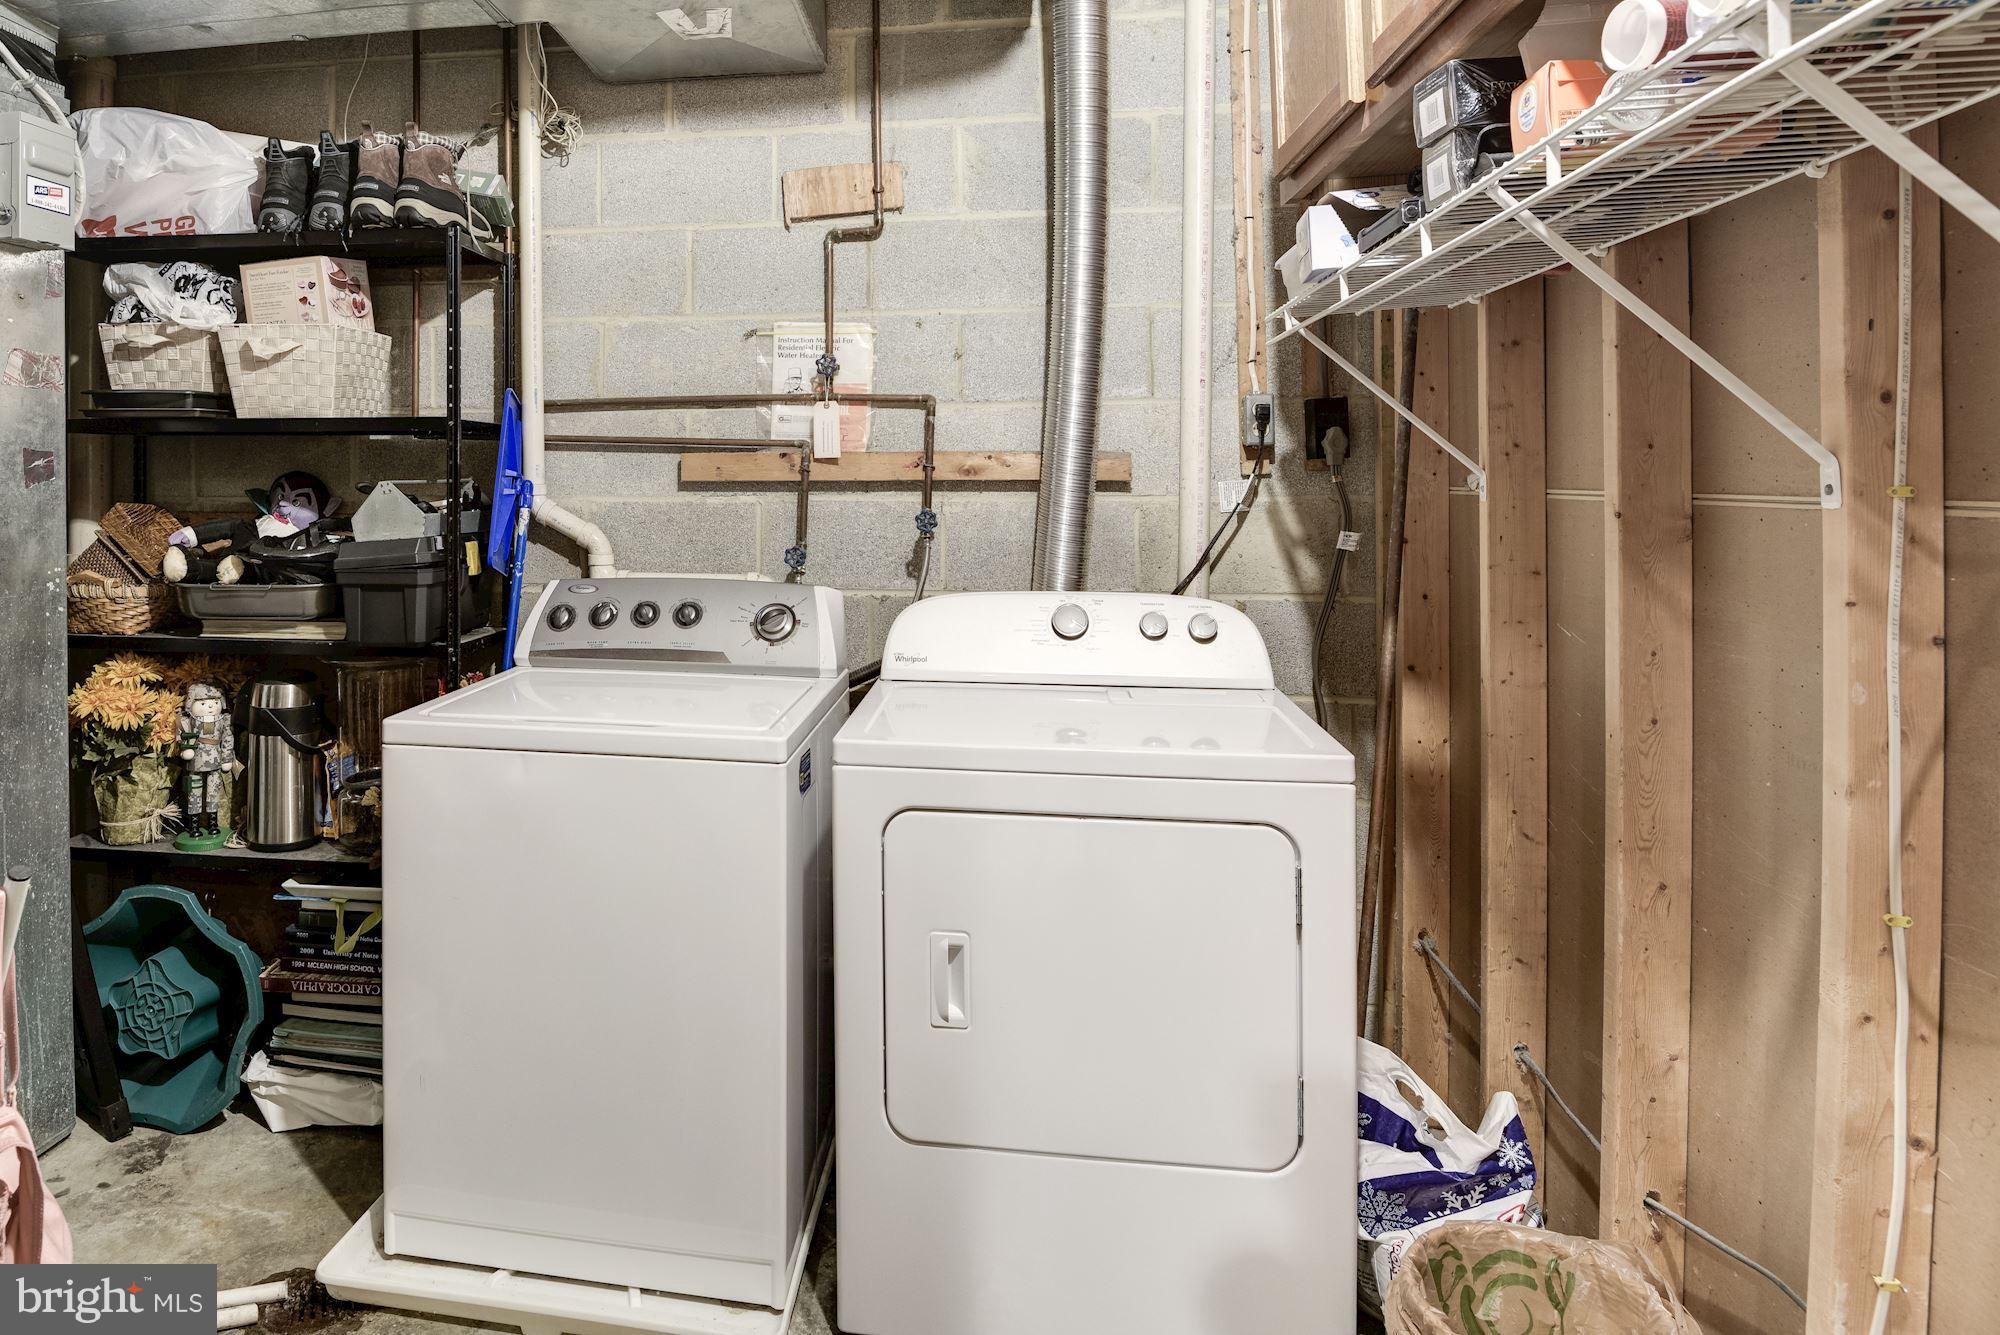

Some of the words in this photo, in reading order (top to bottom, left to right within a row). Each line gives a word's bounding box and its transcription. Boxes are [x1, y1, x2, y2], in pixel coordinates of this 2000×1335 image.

[895, 655, 928, 664] Whirlpool
[307, 961, 333, 969] MCLEAN
[350, 964, 376, 973] SCHOOL
[291, 980, 380, 995] CARTOGRAPHIA
